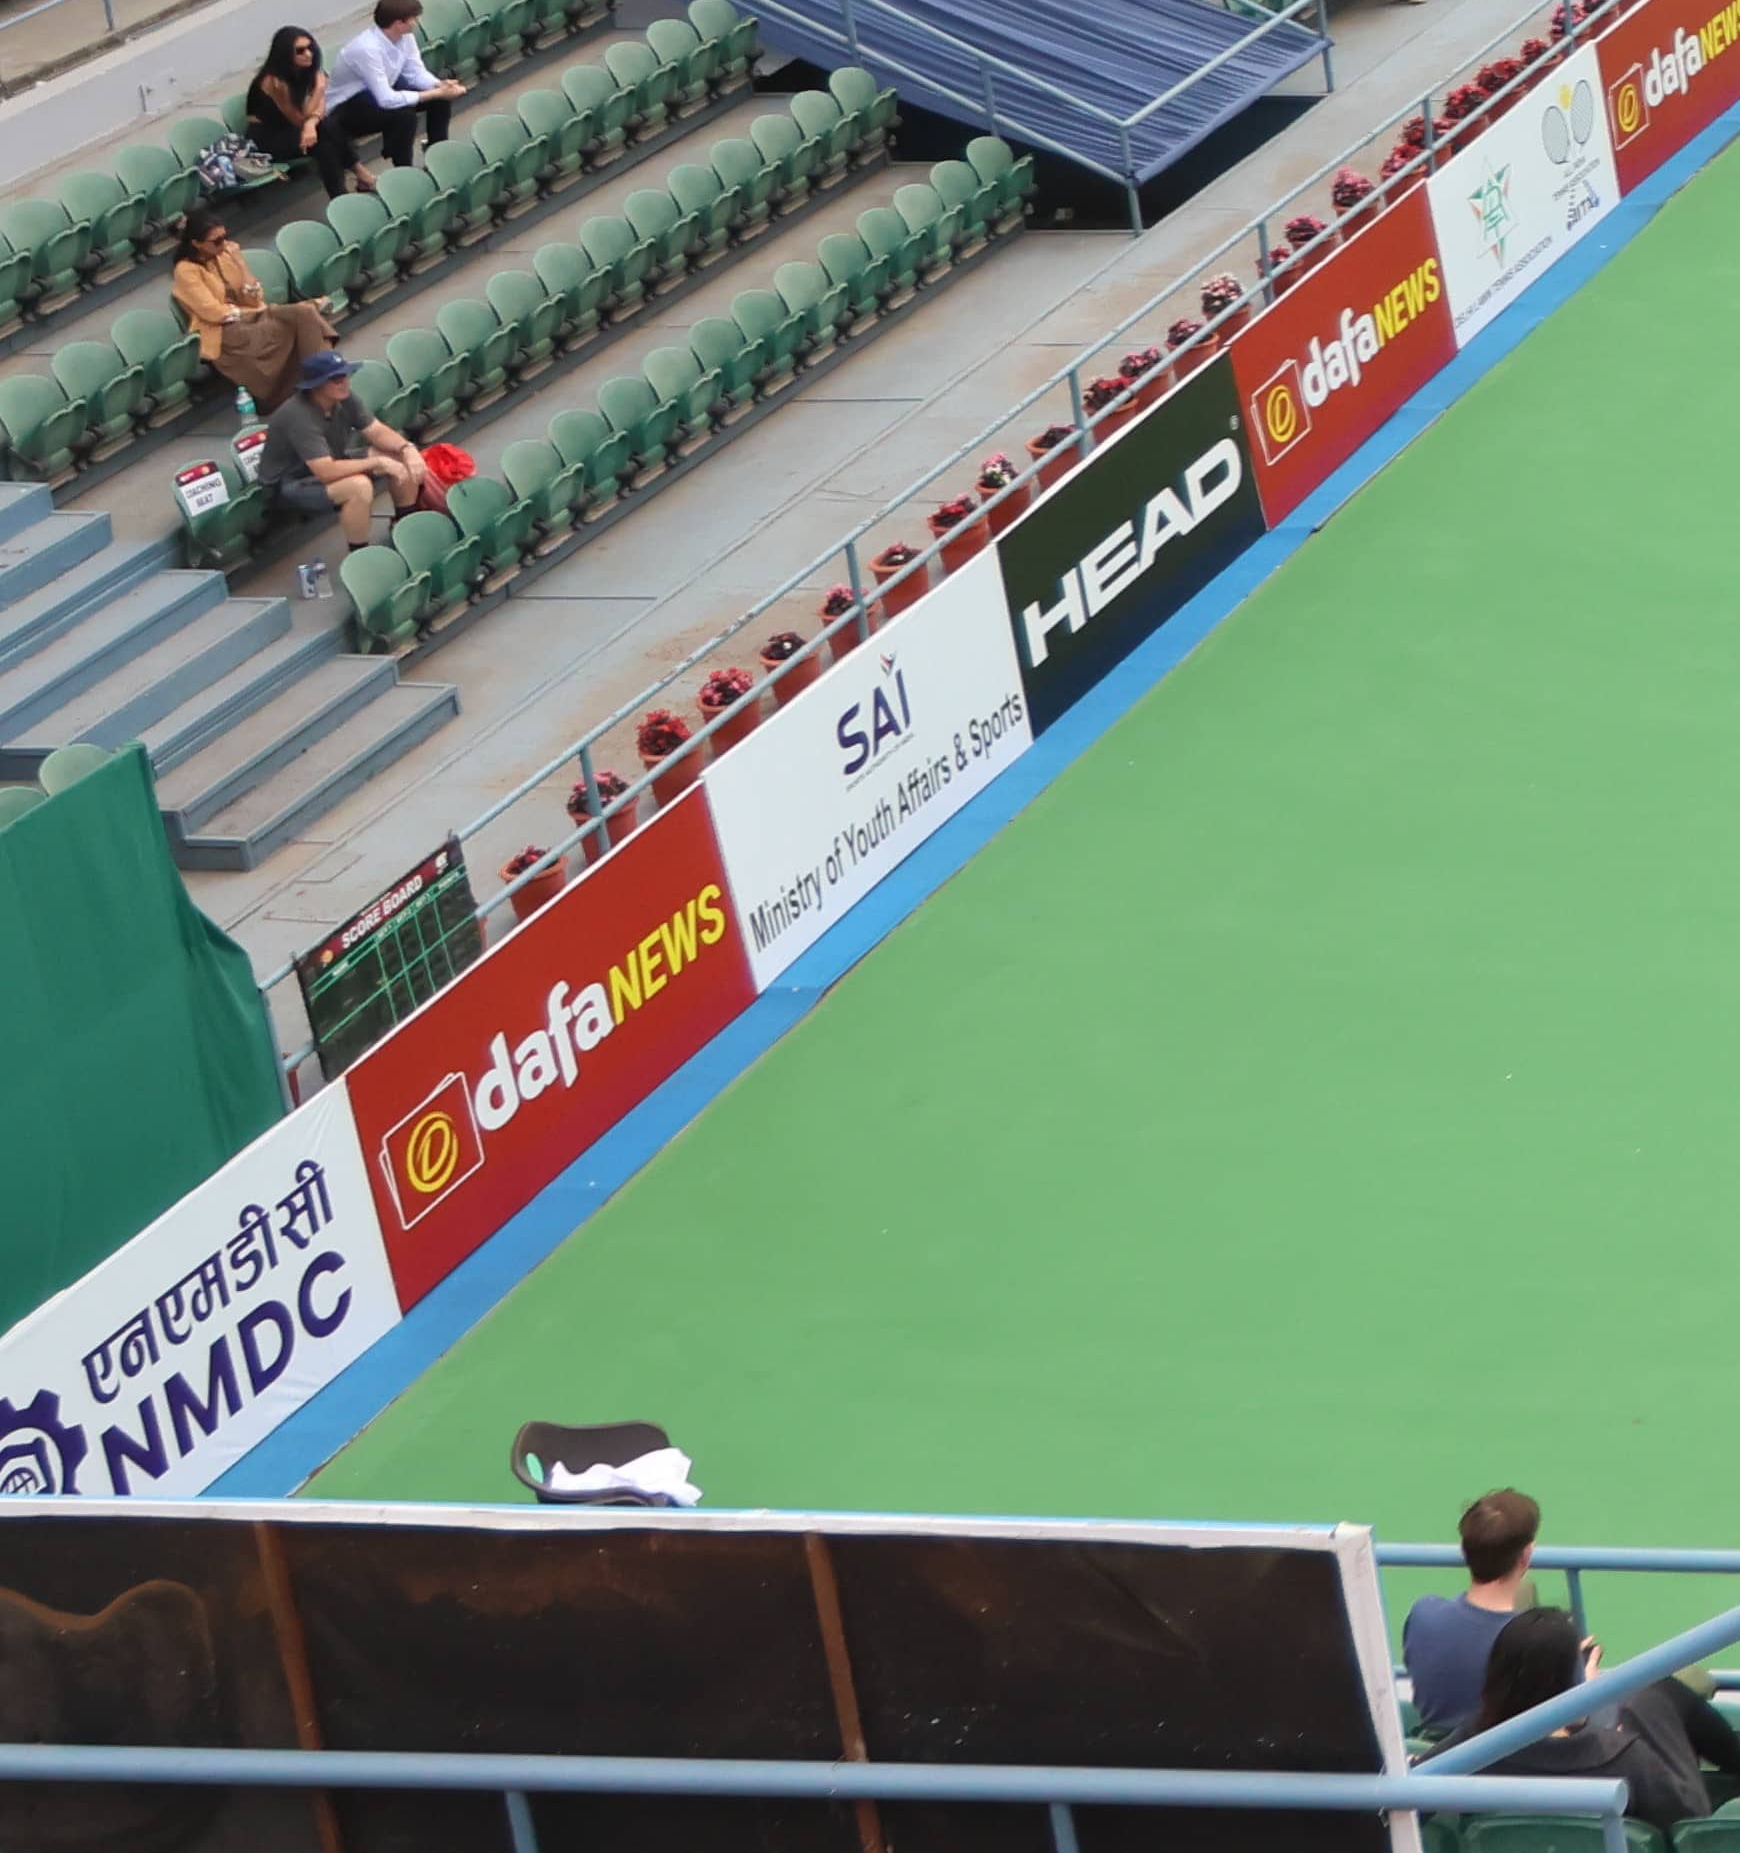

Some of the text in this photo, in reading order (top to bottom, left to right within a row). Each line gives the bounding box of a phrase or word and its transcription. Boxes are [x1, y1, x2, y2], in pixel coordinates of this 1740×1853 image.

[1302, 258, 1440, 407] dafaNEWS
[1023, 438, 1242, 668] HEAD
[749, 867, 821, 953] Ministry
[826, 837, 843, 885] of
[842, 802, 895, 867] Youth
[898, 755, 952, 824] Affairs
[953, 733, 967, 771] &
[969, 691, 1023, 758] Sports
[837, 669, 911, 776] SAI
[342, 907, 381, 948] SCORE
[383, 875, 423, 915] BOARD
[475, 885, 726, 1131] dafaNEWS
[81, 1160, 333, 1404] एनएमडीसी
[101, 1250, 352, 1495] NMDC
